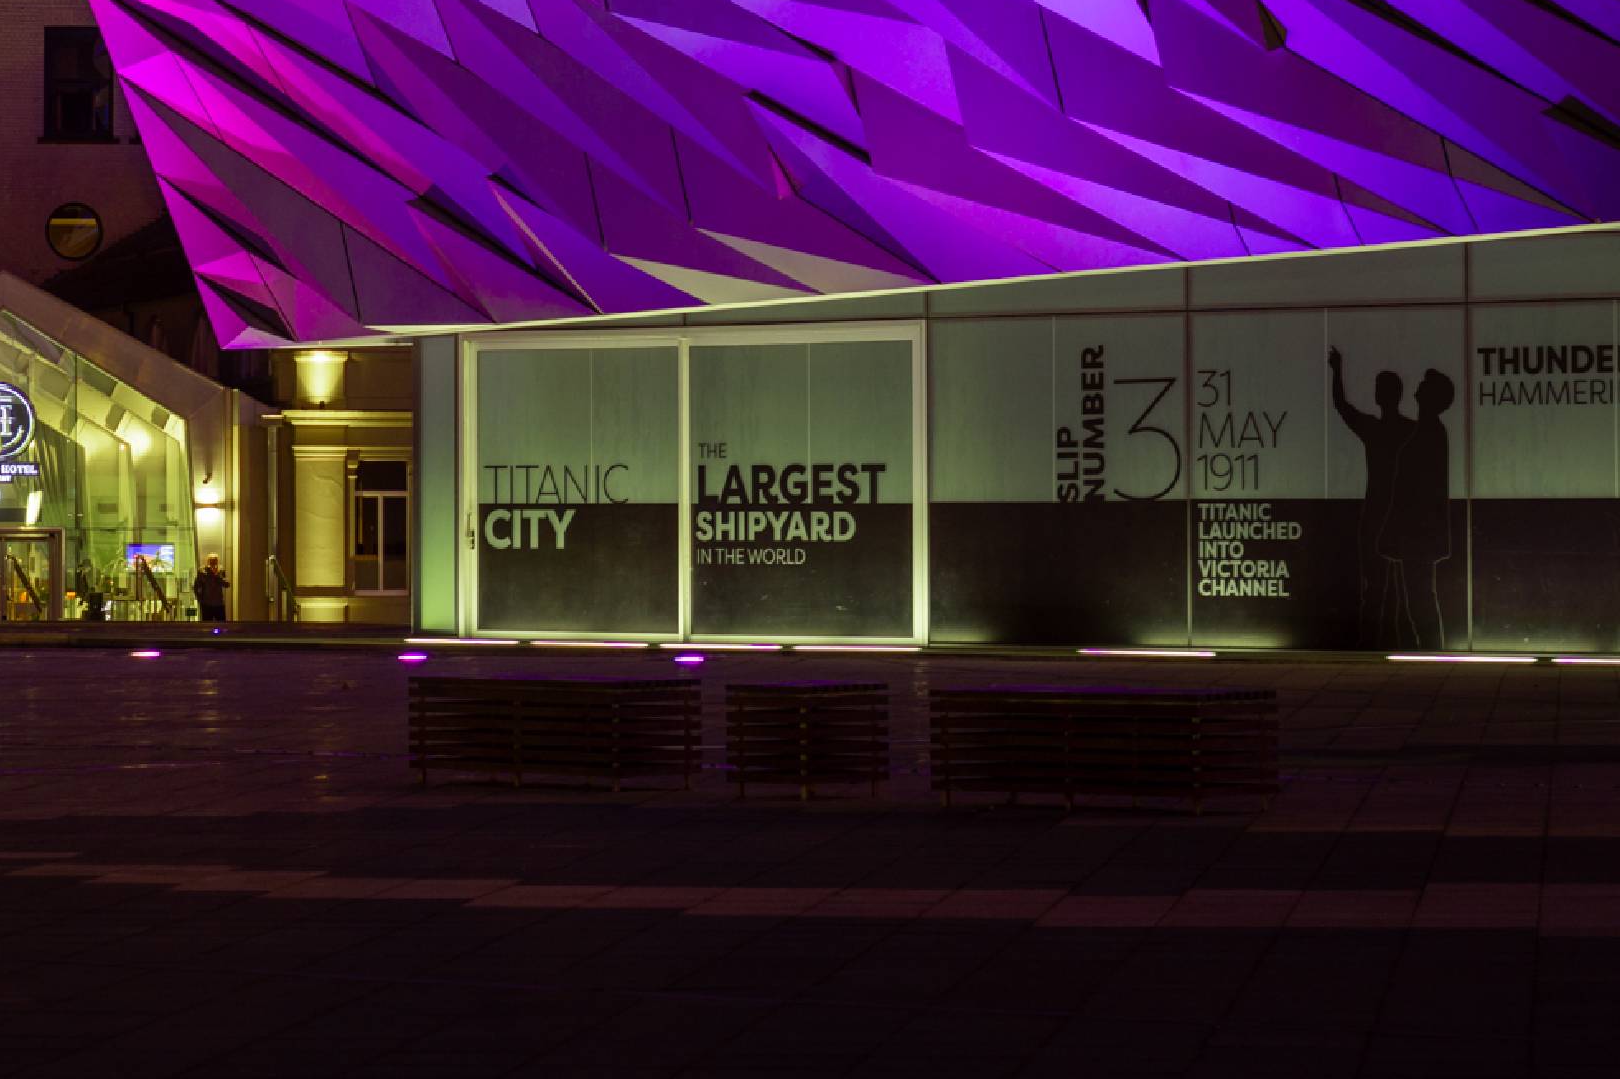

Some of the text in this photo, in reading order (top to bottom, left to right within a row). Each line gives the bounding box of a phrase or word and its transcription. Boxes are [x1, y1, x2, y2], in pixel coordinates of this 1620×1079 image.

[1477, 345, 1620, 375] THUNDE
[1196, 369, 1231, 408] 31
[1080, 344, 1105, 503] NUMBER
[1112, 376, 1181, 502] 3
[1198, 410, 1288, 449] MAY
[698, 442, 727, 459] THE
[1056, 426, 1079, 503] SLIP
[1, 464, 38, 474] HOTEL
[484, 464, 629, 504] TITANIC
[697, 463, 887, 504] LARGEST
[1196, 453, 1260, 491] 1911
[695, 510, 857, 543] SHIPYARD
[1197, 503, 1272, 521] TITANIC
[484, 508, 576, 550] CITY
[1198, 521, 1302, 540] LAUNCHED
[697, 548, 806, 565] IN THE WORLD
[1198, 540, 1244, 559] INTO
[1197, 559, 1290, 578] VICTORIA
[1198, 578, 1290, 597] CHANNEL
